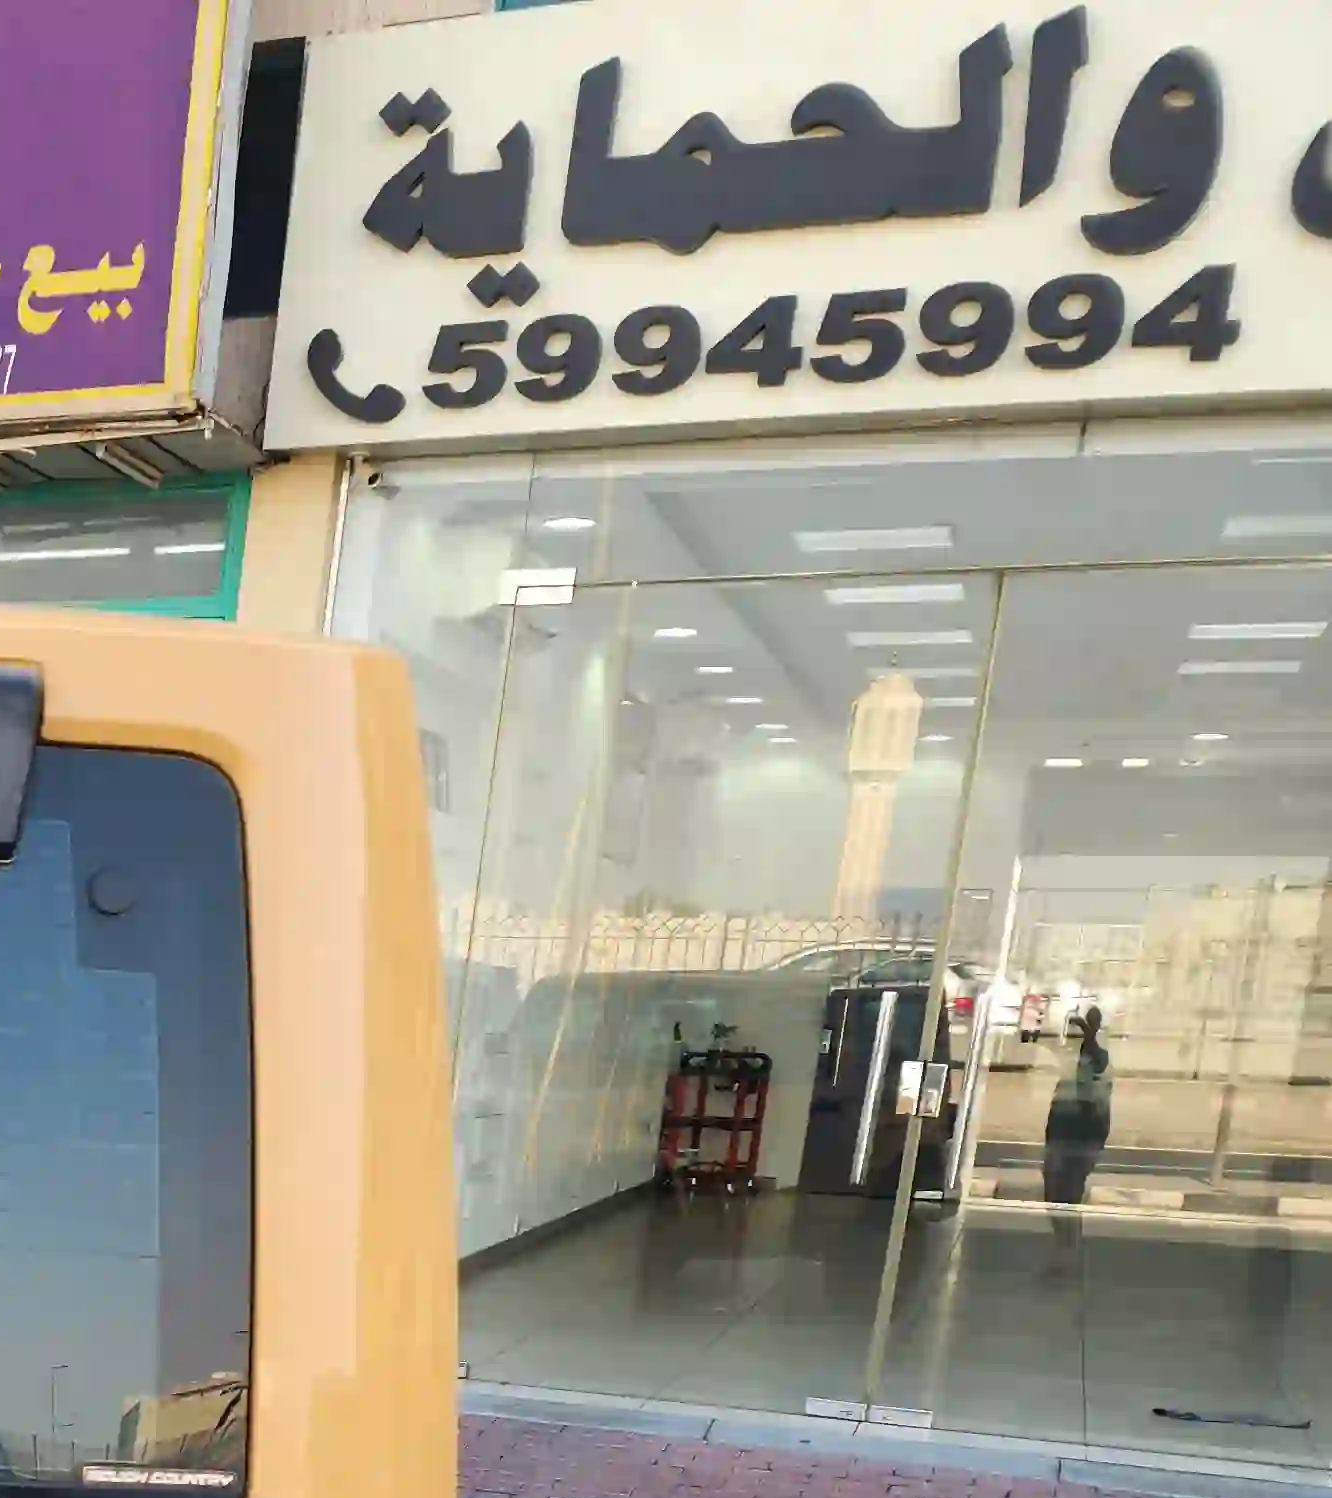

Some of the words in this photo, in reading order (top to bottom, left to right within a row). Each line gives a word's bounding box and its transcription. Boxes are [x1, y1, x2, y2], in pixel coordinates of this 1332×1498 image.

[363, 5, 1224, 309] والحماية
[17, 239, 147, 334] بيع
[421, 263, 1241, 411] 59945994
